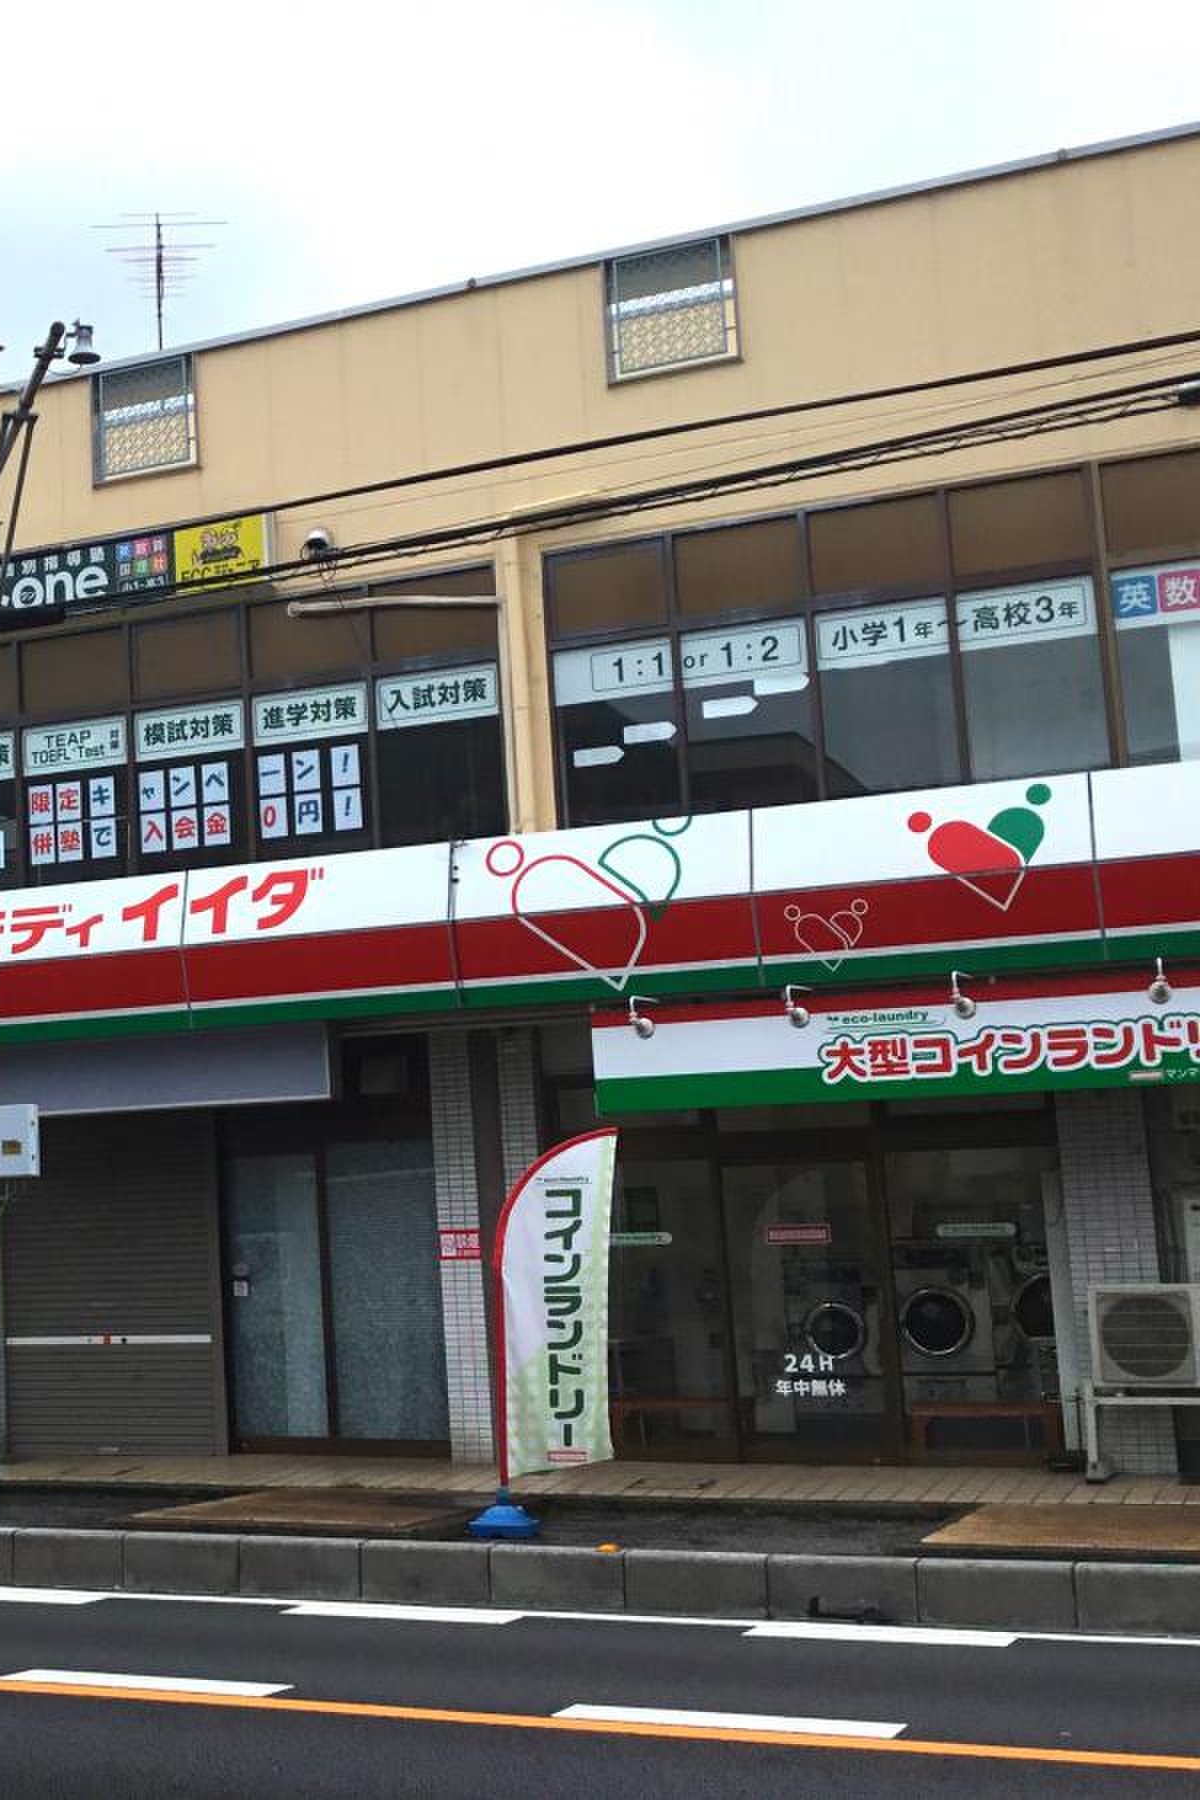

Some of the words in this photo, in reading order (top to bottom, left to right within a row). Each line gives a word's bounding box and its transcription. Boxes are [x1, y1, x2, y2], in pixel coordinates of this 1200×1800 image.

[613, 652, 664, 682] 1:1
[683, 651, 709, 669] or
[720, 636, 779, 667] 1:2
[388, 678, 487, 713] 入試対策
[144, 713, 234, 746] 模試対策
[262, 696, 357, 730] 進学対策
[44, 730, 91, 748] TEAP
[121, 866, 325, 942] イイダ
[544, 1188, 584, 1447] コインランドリー
[784, 1354, 833, 1372] 24H
[775, 1379, 847, 1397] 年中無休
